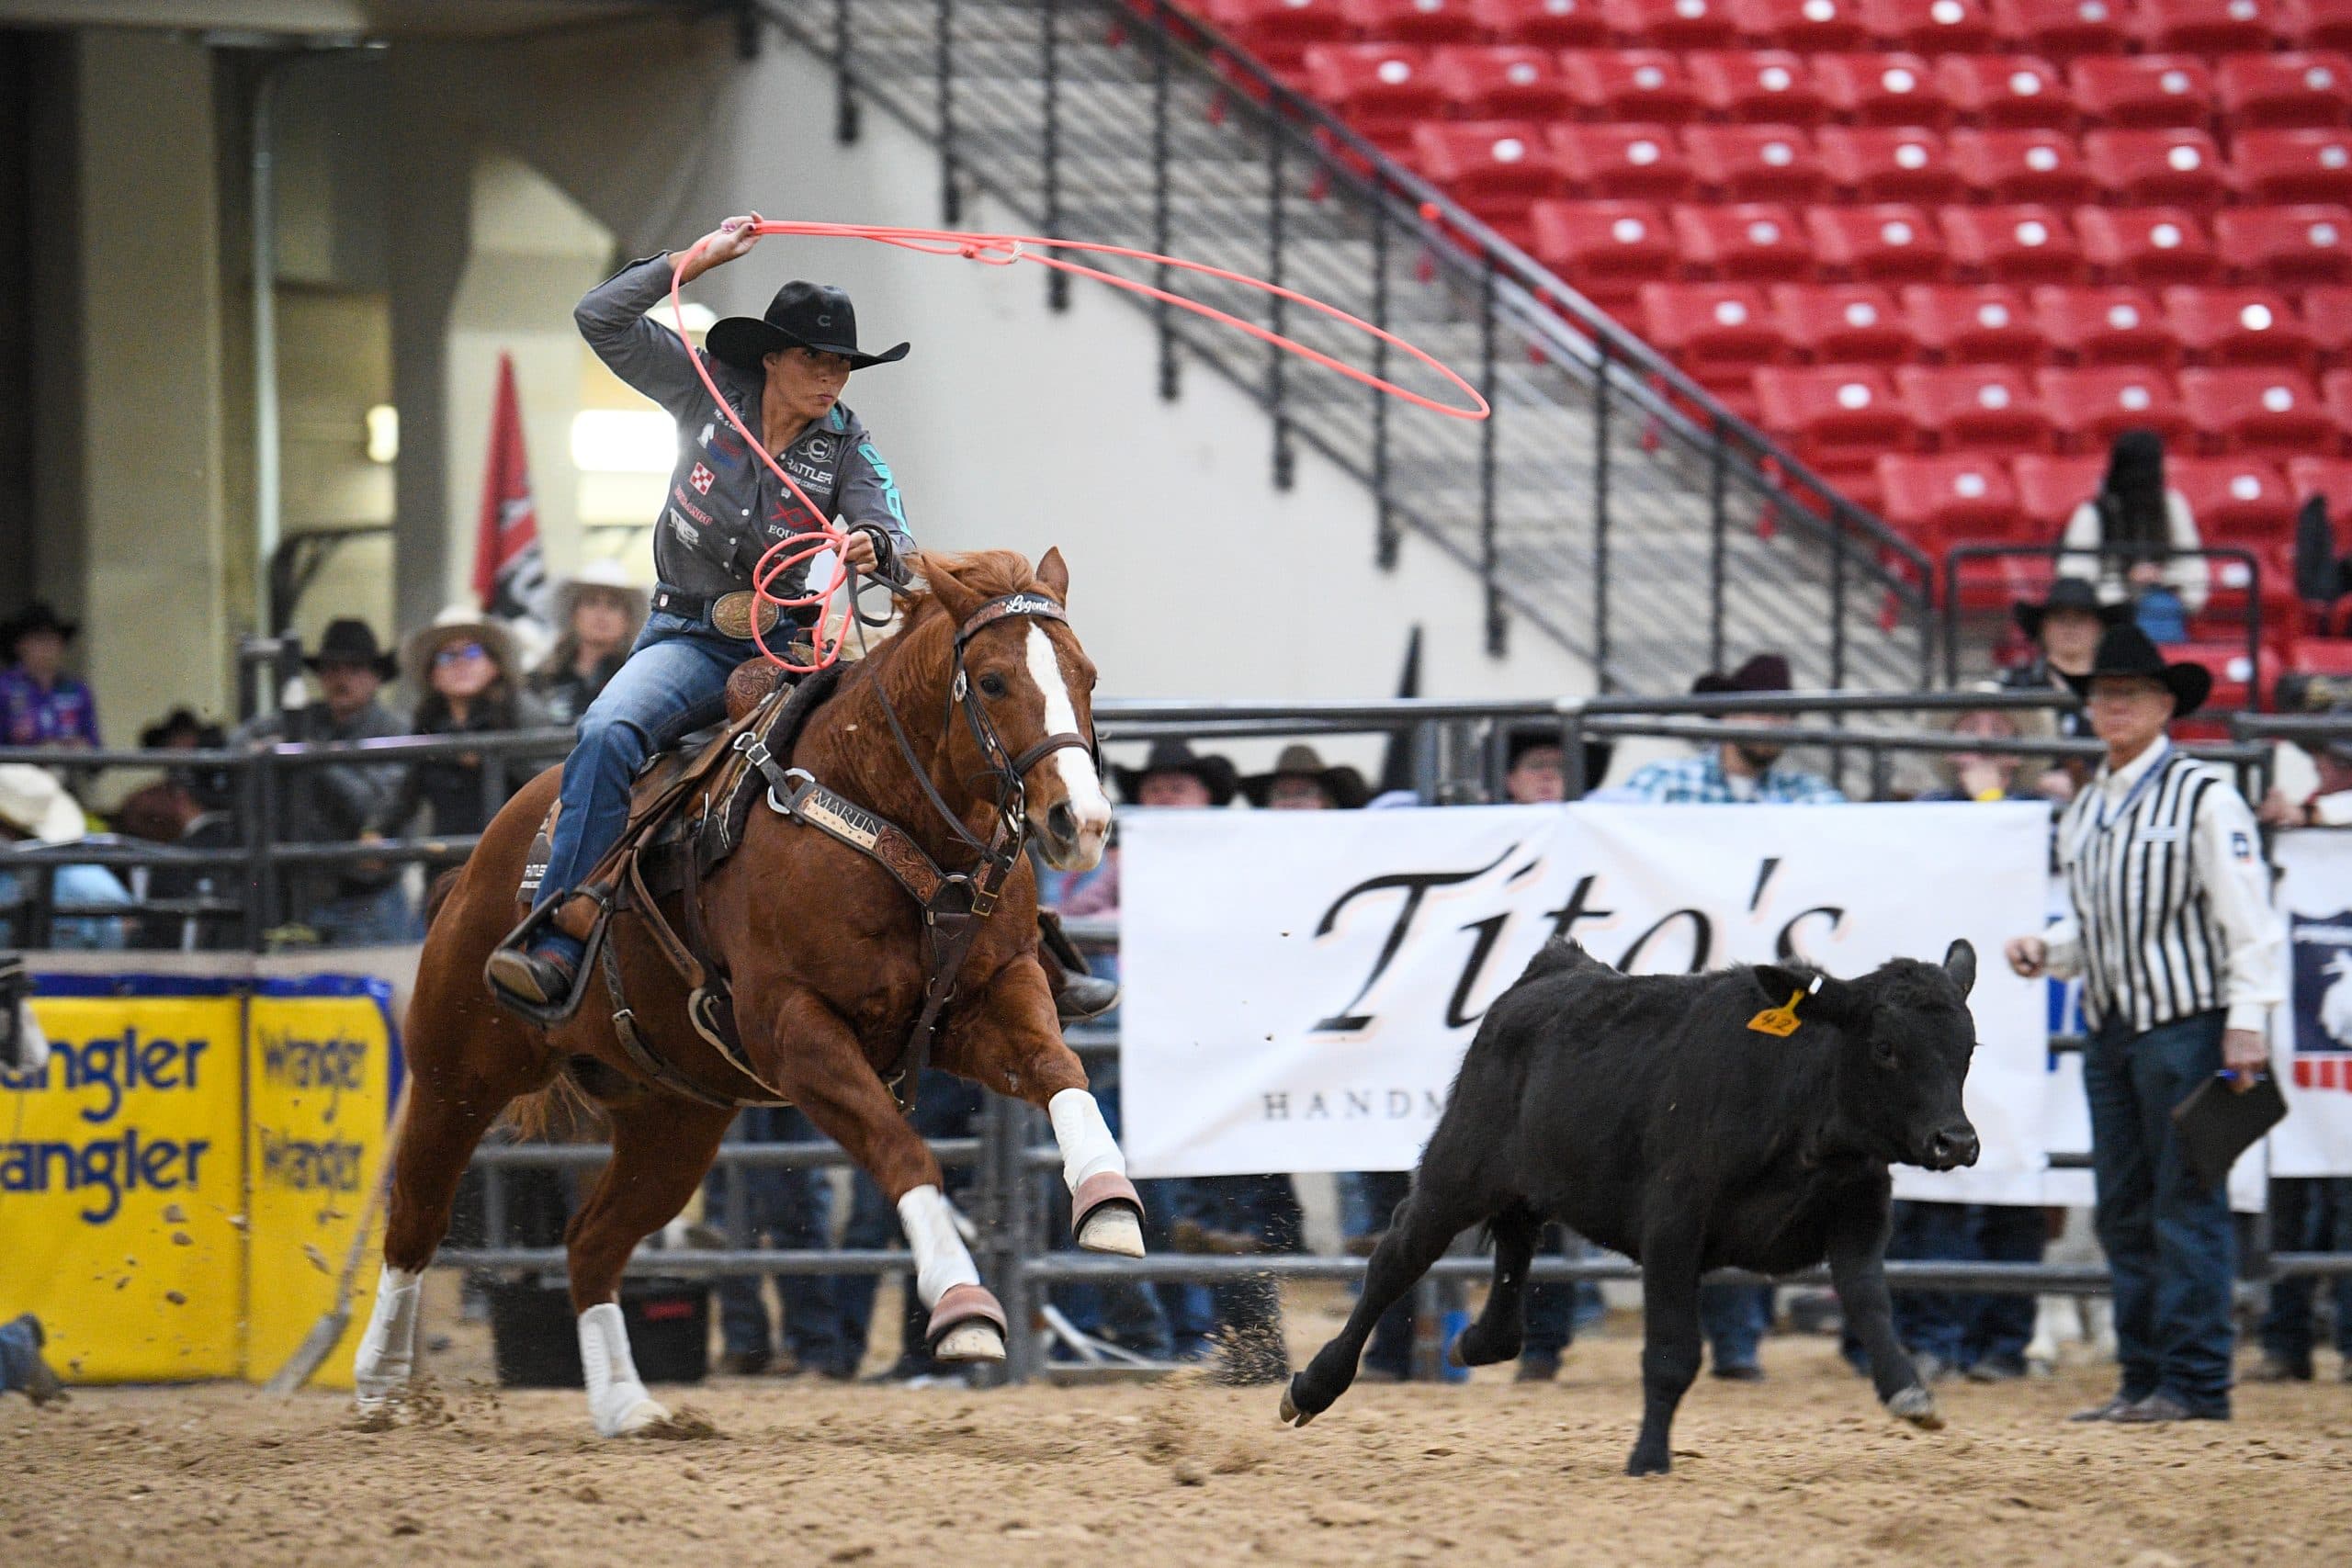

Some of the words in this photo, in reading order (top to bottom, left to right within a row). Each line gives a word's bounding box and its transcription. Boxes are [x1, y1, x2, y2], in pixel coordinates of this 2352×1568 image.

[817, 314, 831, 327] C
[786, 458, 833, 485] RATTLER
[1005, 594, 1049, 615] Legend
[813, 790, 884, 838] MARTIN
